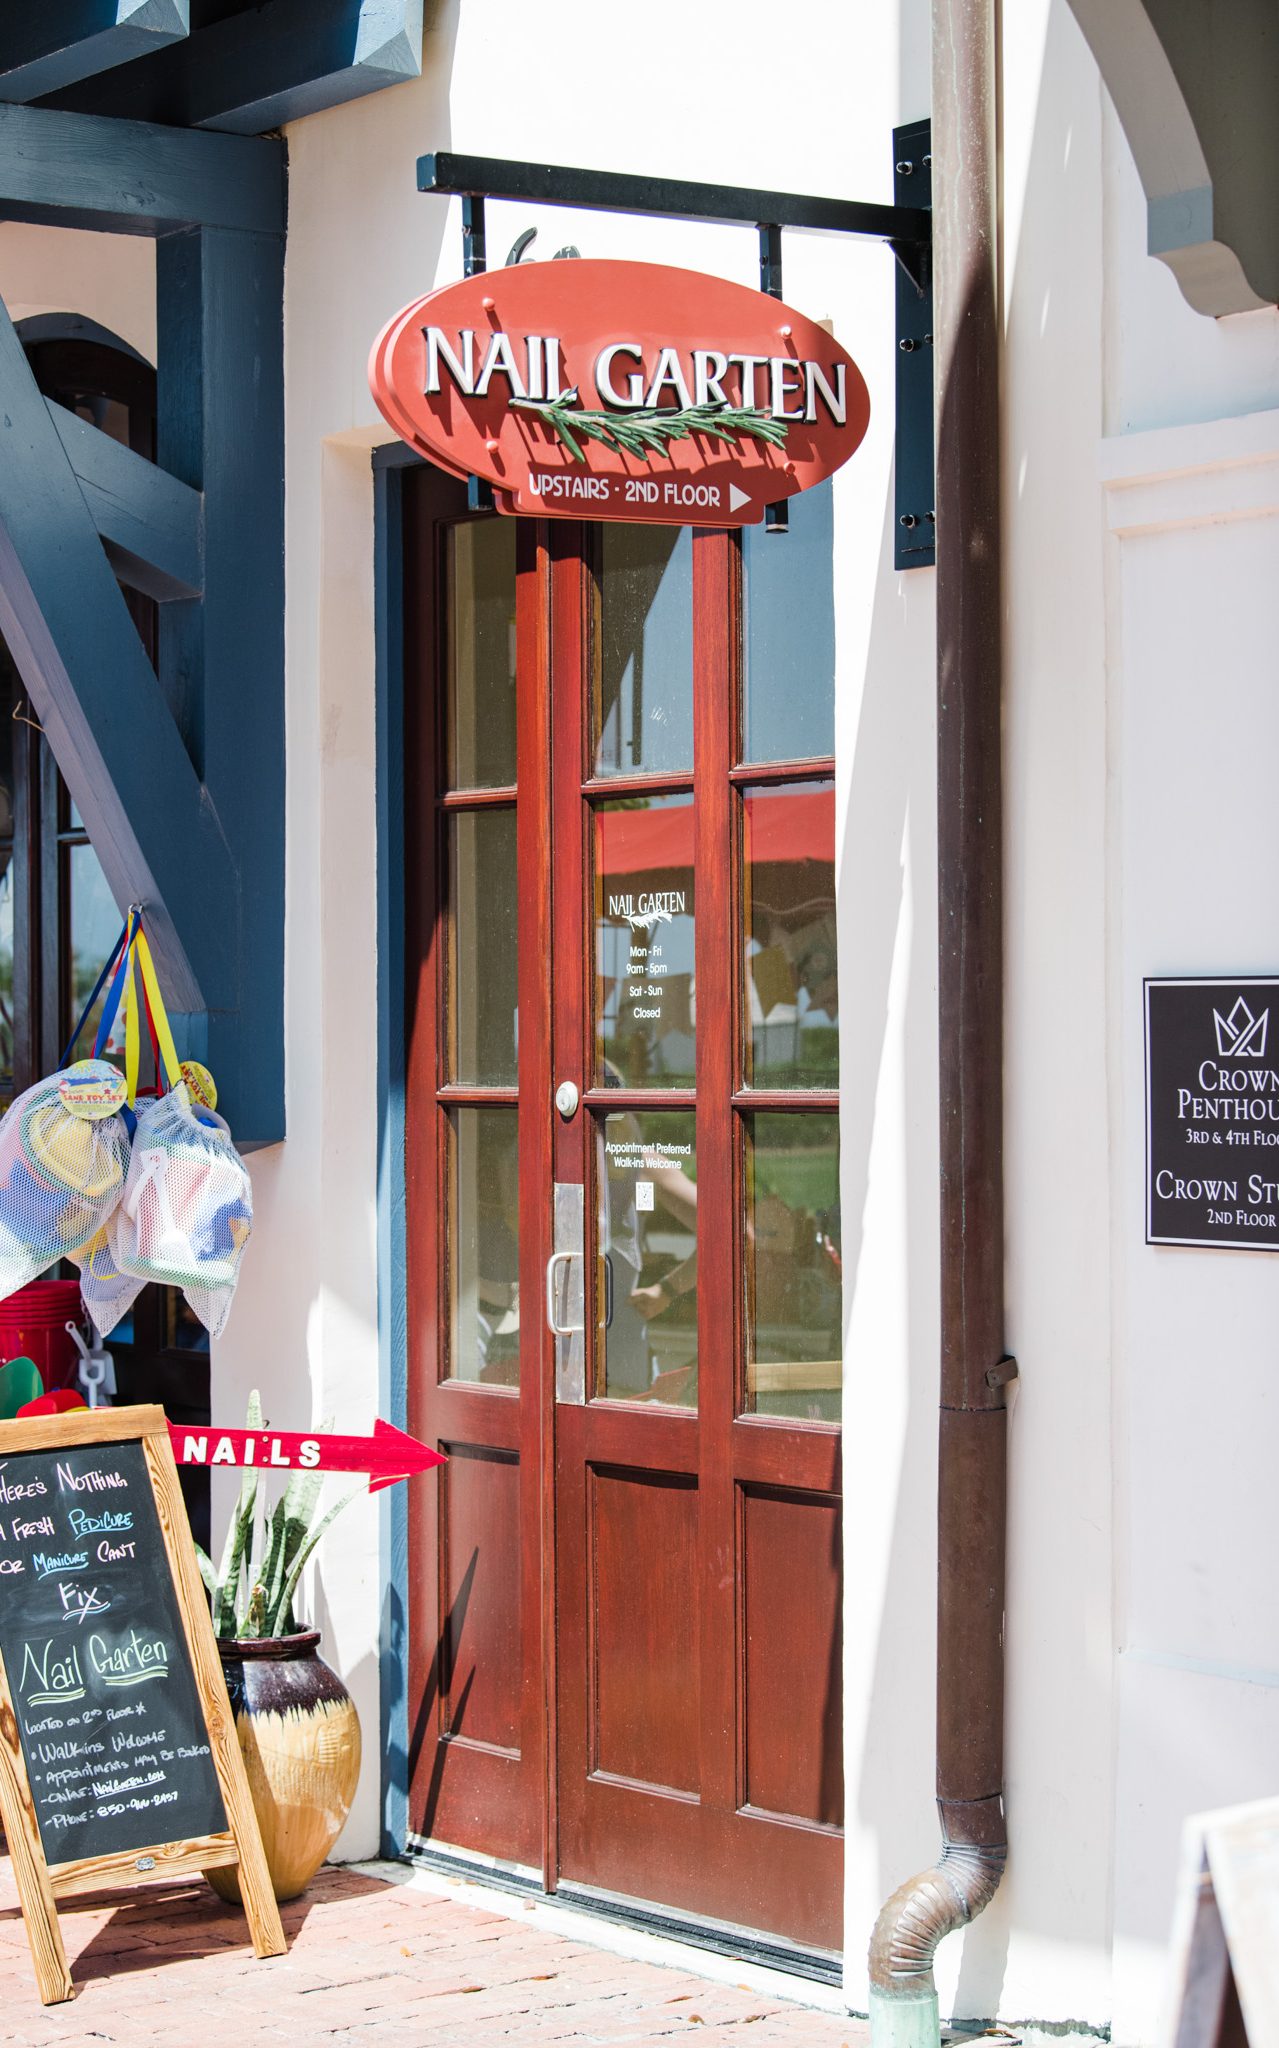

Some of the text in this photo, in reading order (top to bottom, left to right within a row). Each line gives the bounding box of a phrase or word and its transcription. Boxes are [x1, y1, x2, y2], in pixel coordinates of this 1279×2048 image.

[422, 326, 848, 427] NAIL GARTEN
[528, 473, 610, 501] UPSTAIRS
[625, 480, 660, 505] 2ND
[664, 483, 721, 508] FLOOR
[609, 891, 686, 916] NAIL GARTEN
[629, 946, 647, 957] Mon
[652, 945, 662, 956] Fri
[626, 963, 644, 975] 9am
[649, 963, 668, 976] 5pm
[629, 986, 642, 997] Sat
[648, 985, 663, 996] Sun
[633, 1007, 661, 1019] Closed
[1185, 1128, 1210, 1144] 3RD
[1212, 1131, 1223, 1144] &
[1225, 1129, 1250, 1146] 4TH
[605, 1142, 692, 1155] Appointment Preferred
[614, 1157, 682, 1169] Walk-ins Welcome
[1156, 1169, 1279, 1204] CROWN ST
[1207, 1208, 1277, 1228] 2ND FLOOR
[182, 1435, 322, 1468] NAILS
[12, 1516, 56, 1541] FRESH
[0, 1559, 26, 1574] OR
[19, 1630, 168, 1693] Nail Garten
